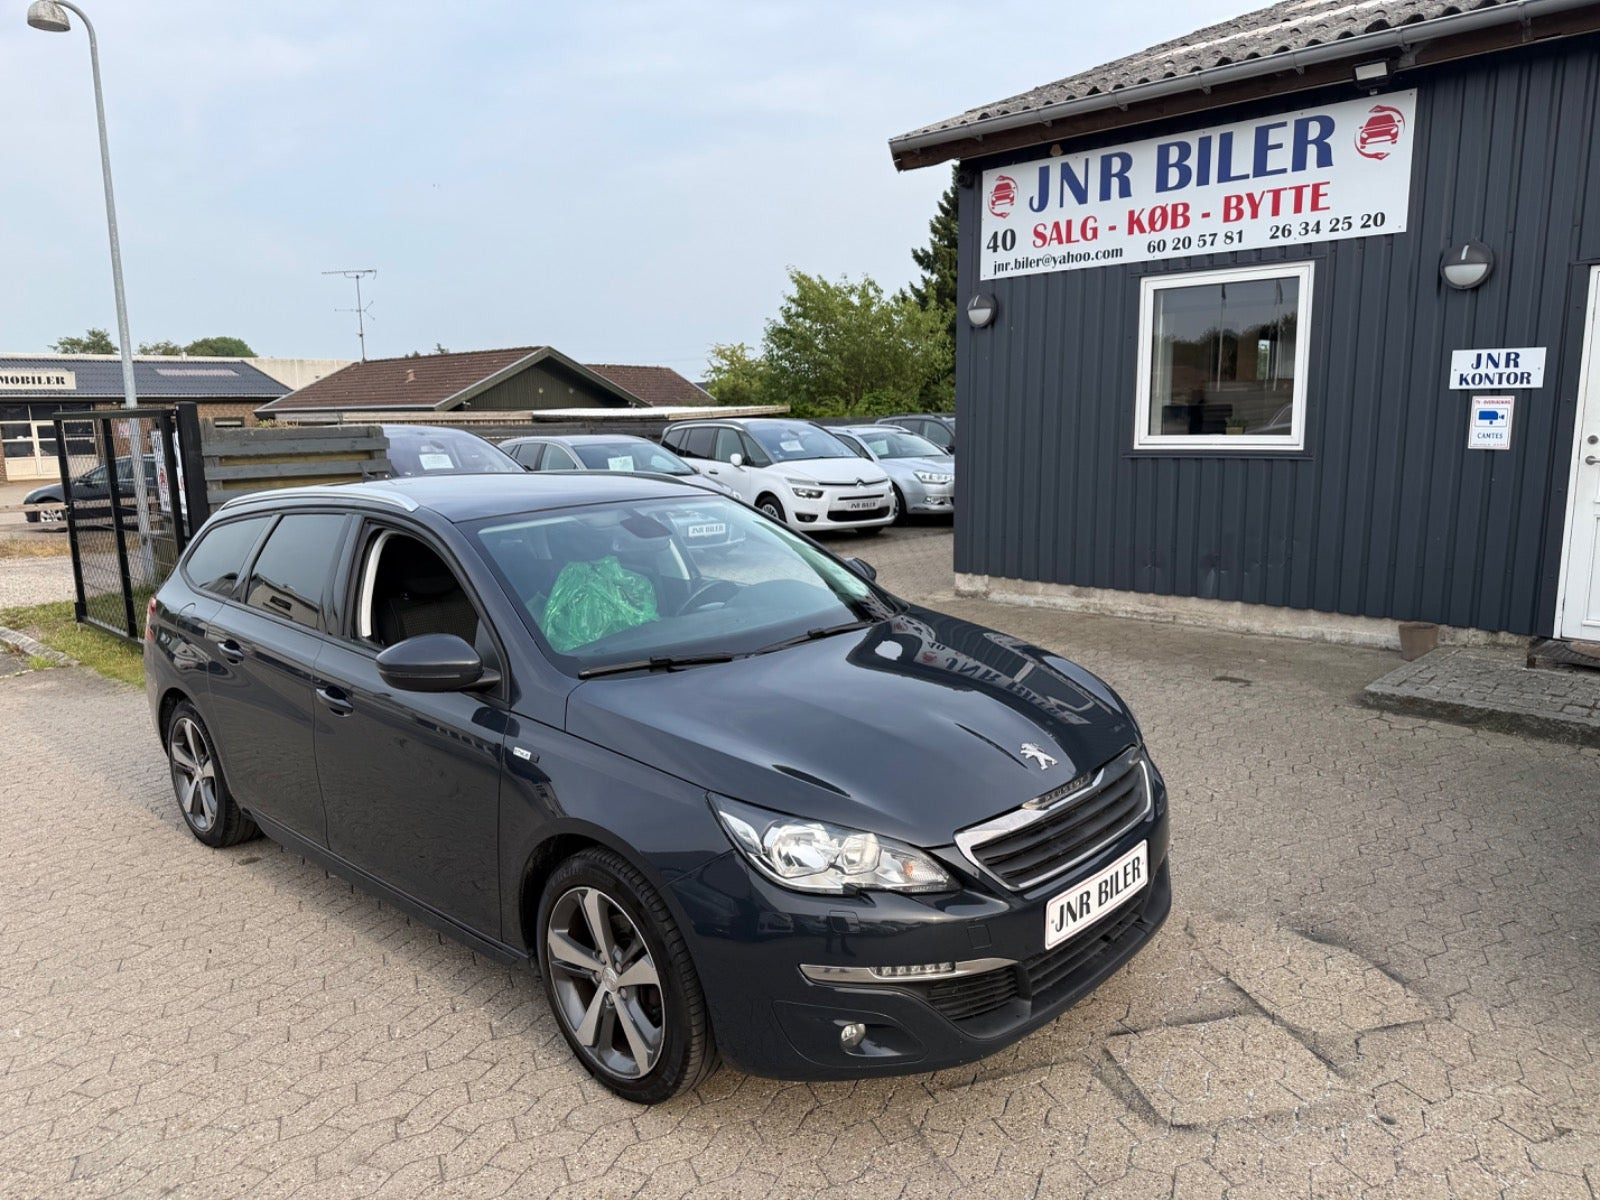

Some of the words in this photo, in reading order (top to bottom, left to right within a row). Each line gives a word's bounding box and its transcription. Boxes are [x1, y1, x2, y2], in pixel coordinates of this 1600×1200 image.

[1029, 151, 1133, 213] JNR
[1155, 114, 1336, 194] BILER
[1032, 215, 1099, 249] SALG
[1127, 202, 1191, 236] KØB
[1222, 181, 1331, 223] BYTTE
[1269, 224, 1292, 240] 26
[1298, 219, 1322, 236] 34
[1329, 216, 1353, 233] 25
[1360, 211, 1386, 229] 20
[986, 228, 1016, 253] 40
[1147, 239, 1167, 254] 60
[1172, 235, 1192, 251] 20
[1197, 232, 1218, 248] 57
[1224, 229, 1244, 245] 81
[993, 248, 1124, 275] jnr.biler@yahoo.com
[1471, 352, 1520, 370] JNR
[1458, 371, 1532, 386] KONTOR
[1054, 889, 1091, 933] JNR
[1097, 855, 1141, 908] BILER
